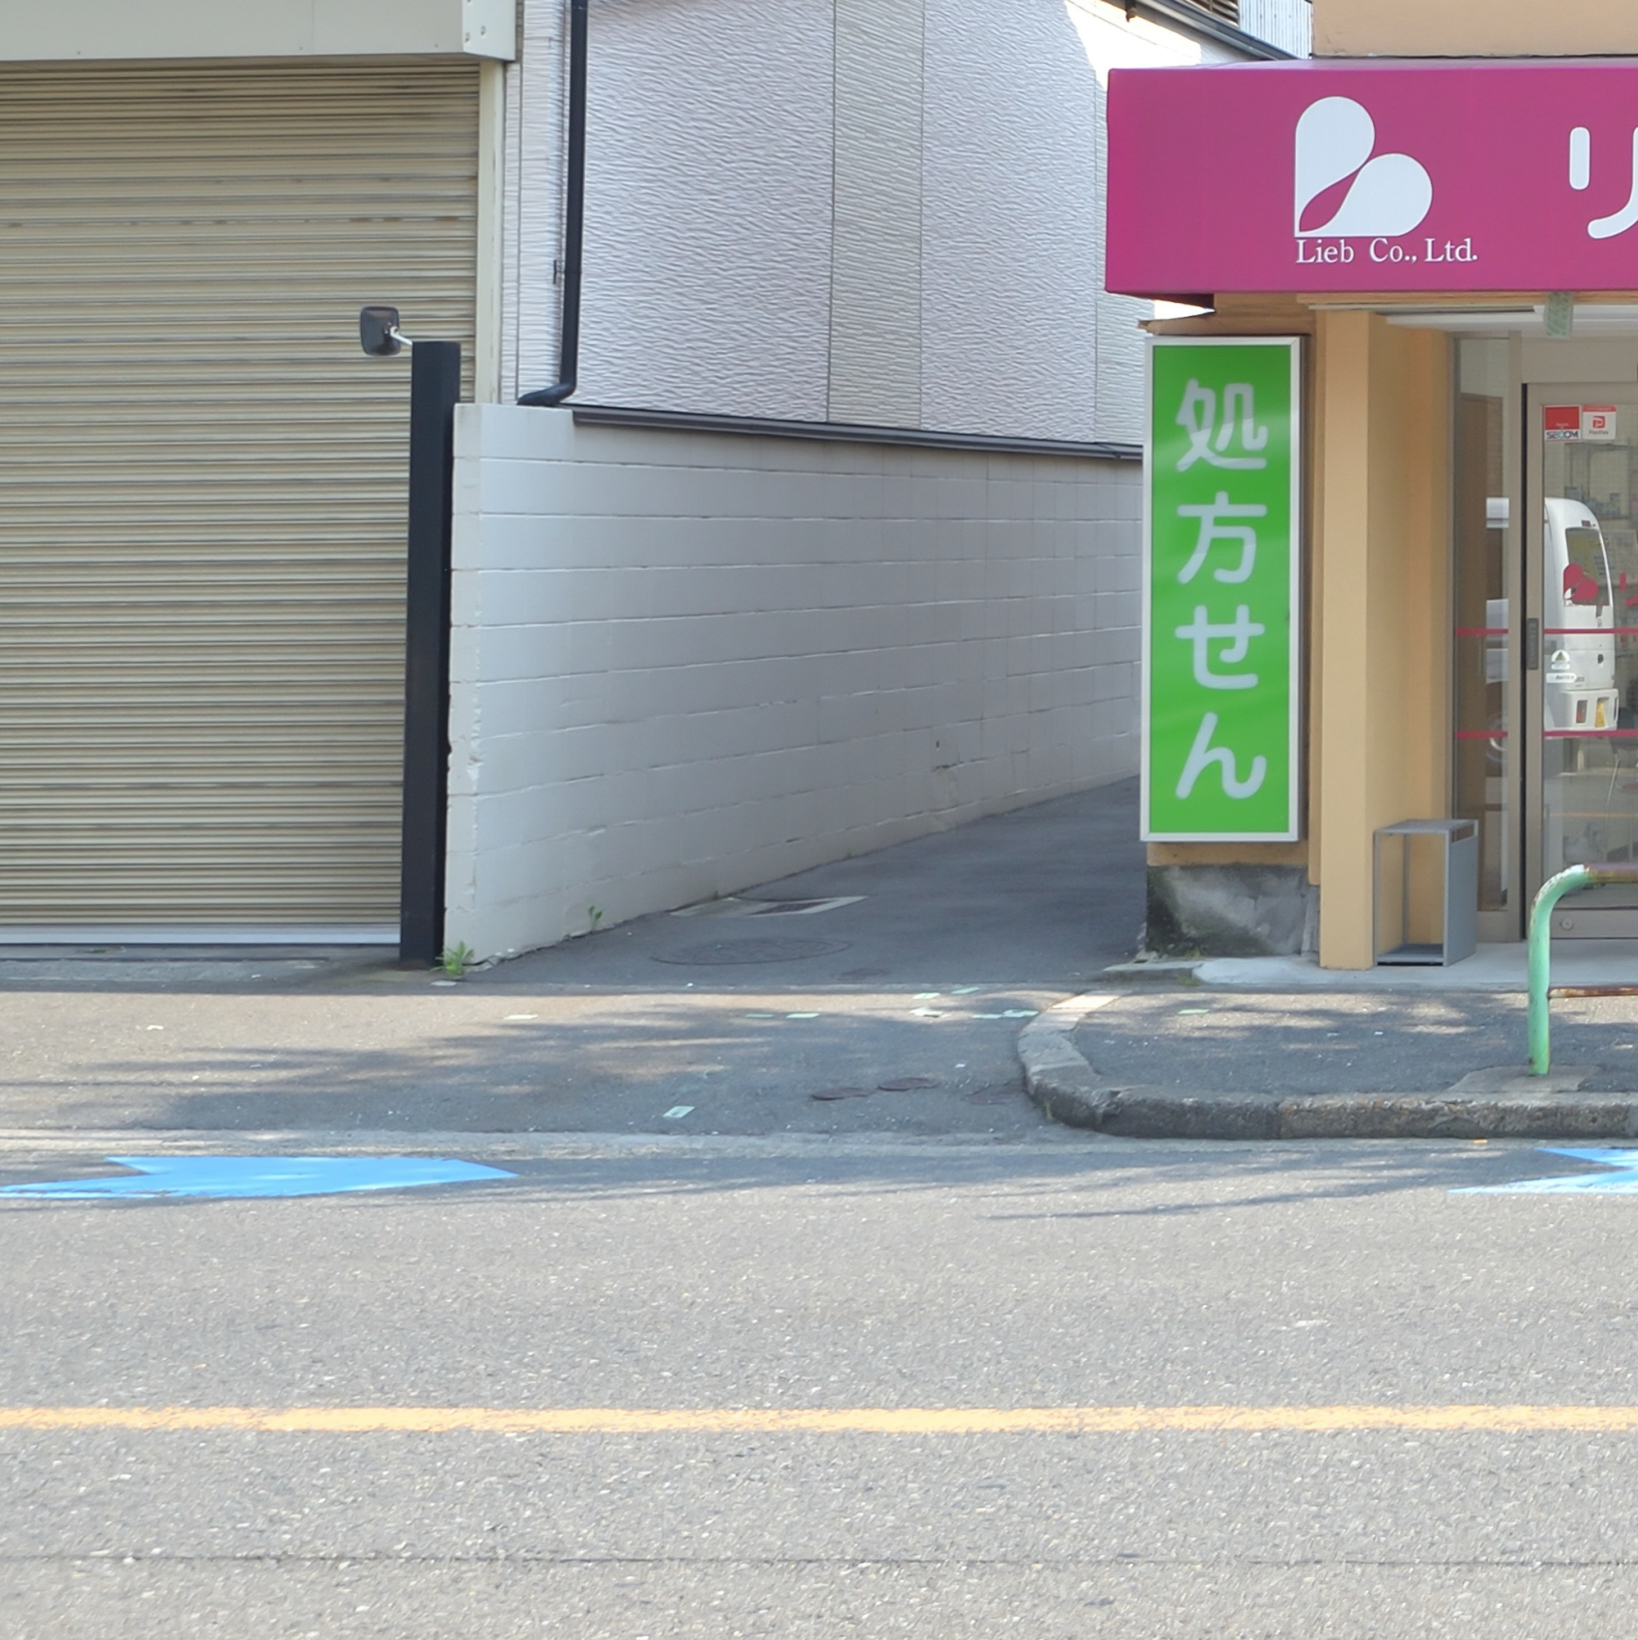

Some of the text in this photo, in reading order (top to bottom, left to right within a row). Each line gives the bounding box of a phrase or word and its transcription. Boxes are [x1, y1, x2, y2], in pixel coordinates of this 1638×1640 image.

[1296, 237, 1478, 263] Lieb Co., Ltd.
[1546, 431, 1579, 439] SECOM
[1174, 378, 1269, 800] 処方せん
